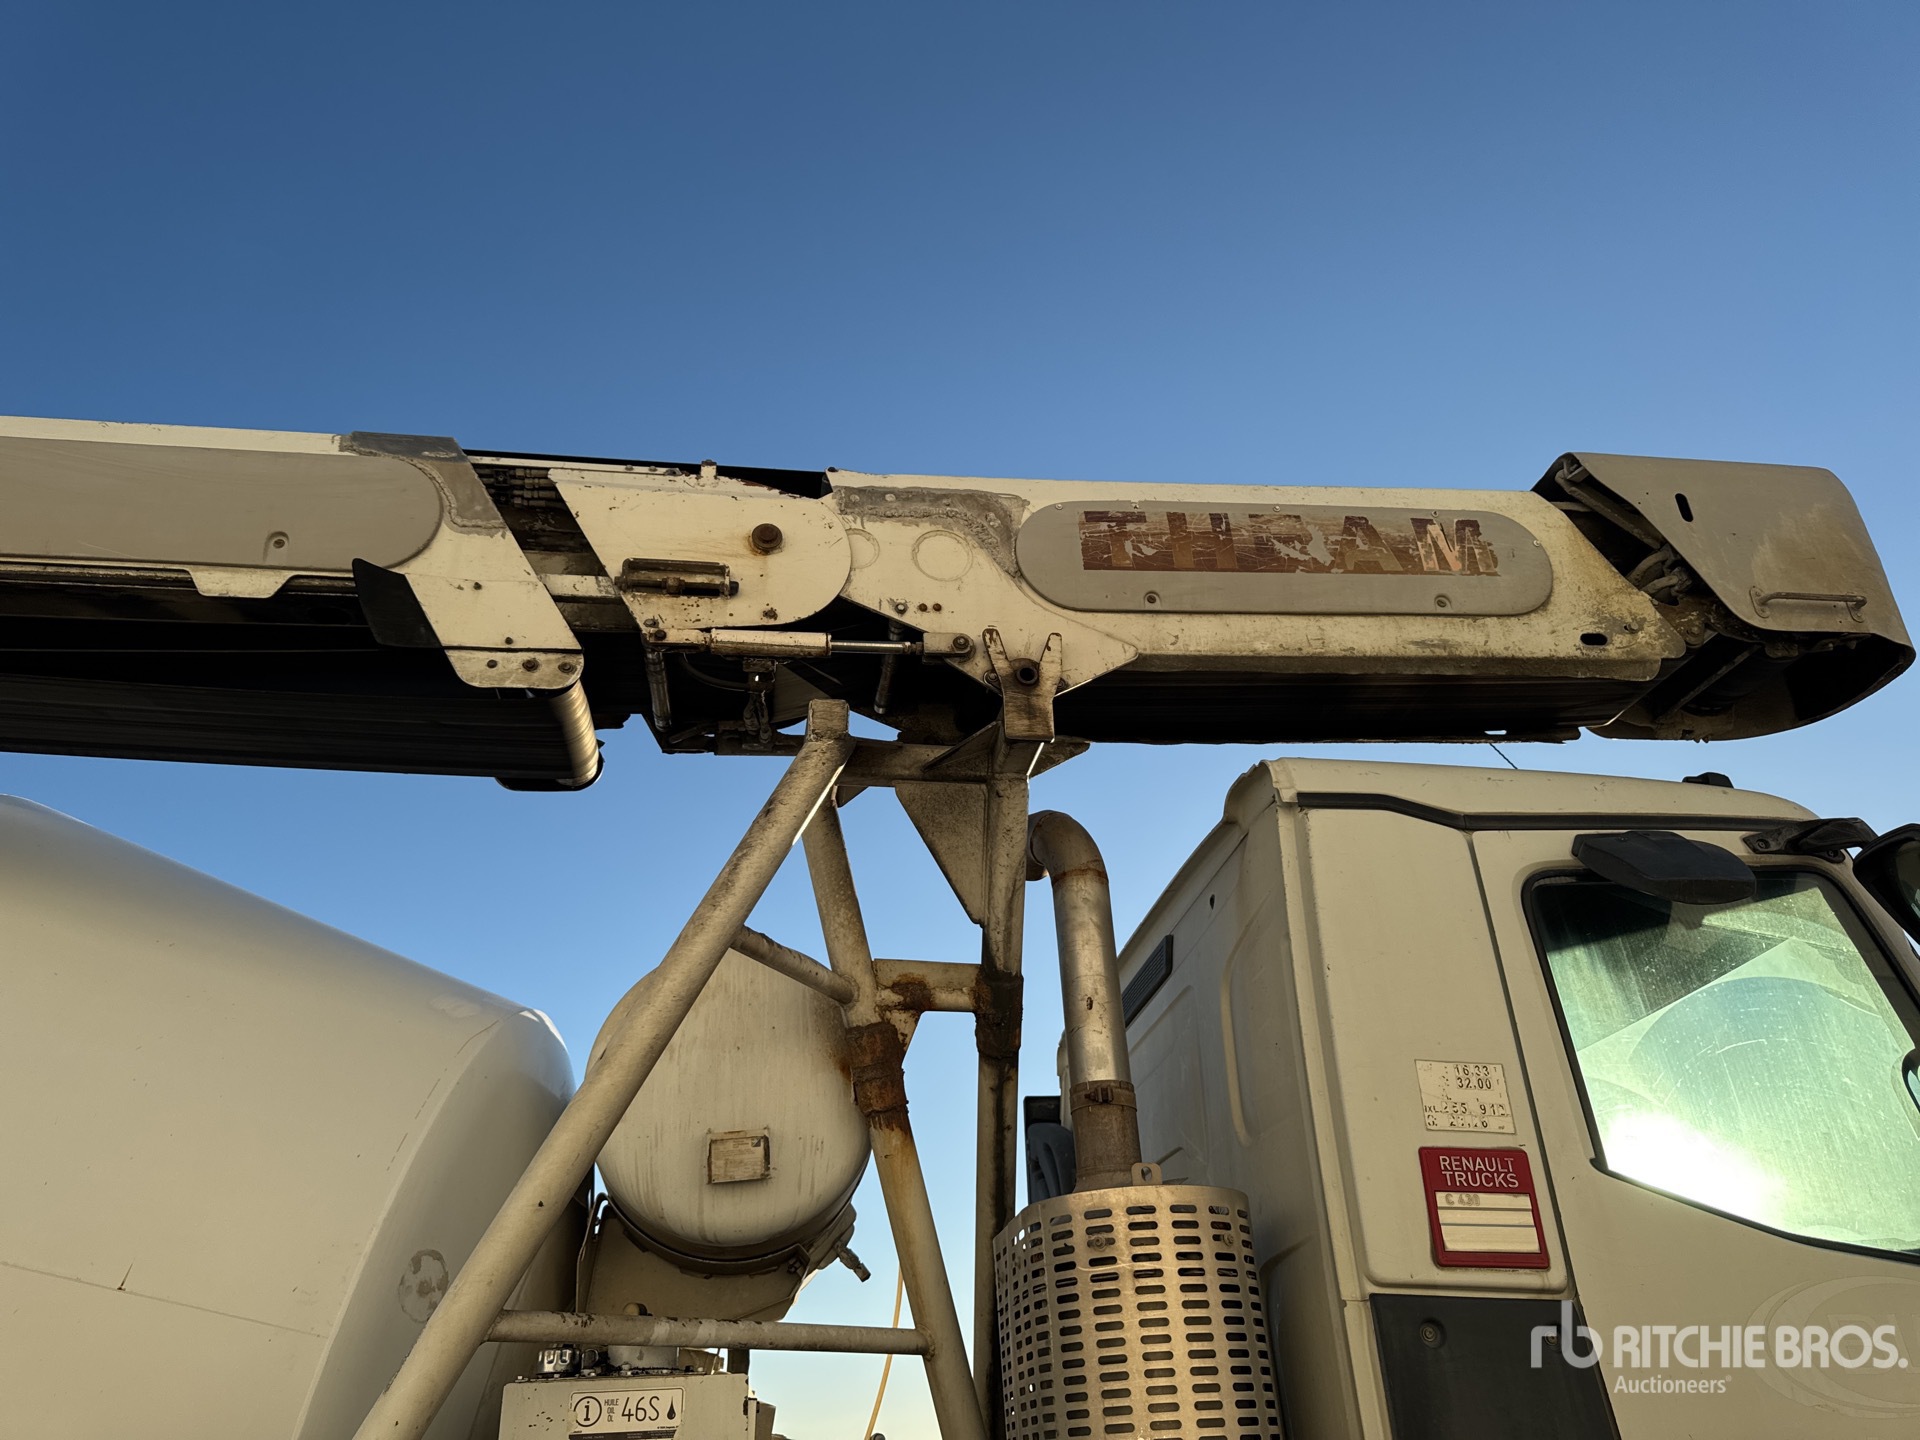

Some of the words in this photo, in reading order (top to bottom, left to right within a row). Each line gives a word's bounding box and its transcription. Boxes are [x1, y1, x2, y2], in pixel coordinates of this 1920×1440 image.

[1439, 1155, 1514, 1172] RENAULT
[1441, 1171, 1519, 1188] TRUCKS
[604, 1398, 619, 1406] HUILE
[621, 1395, 660, 1423] 46S
